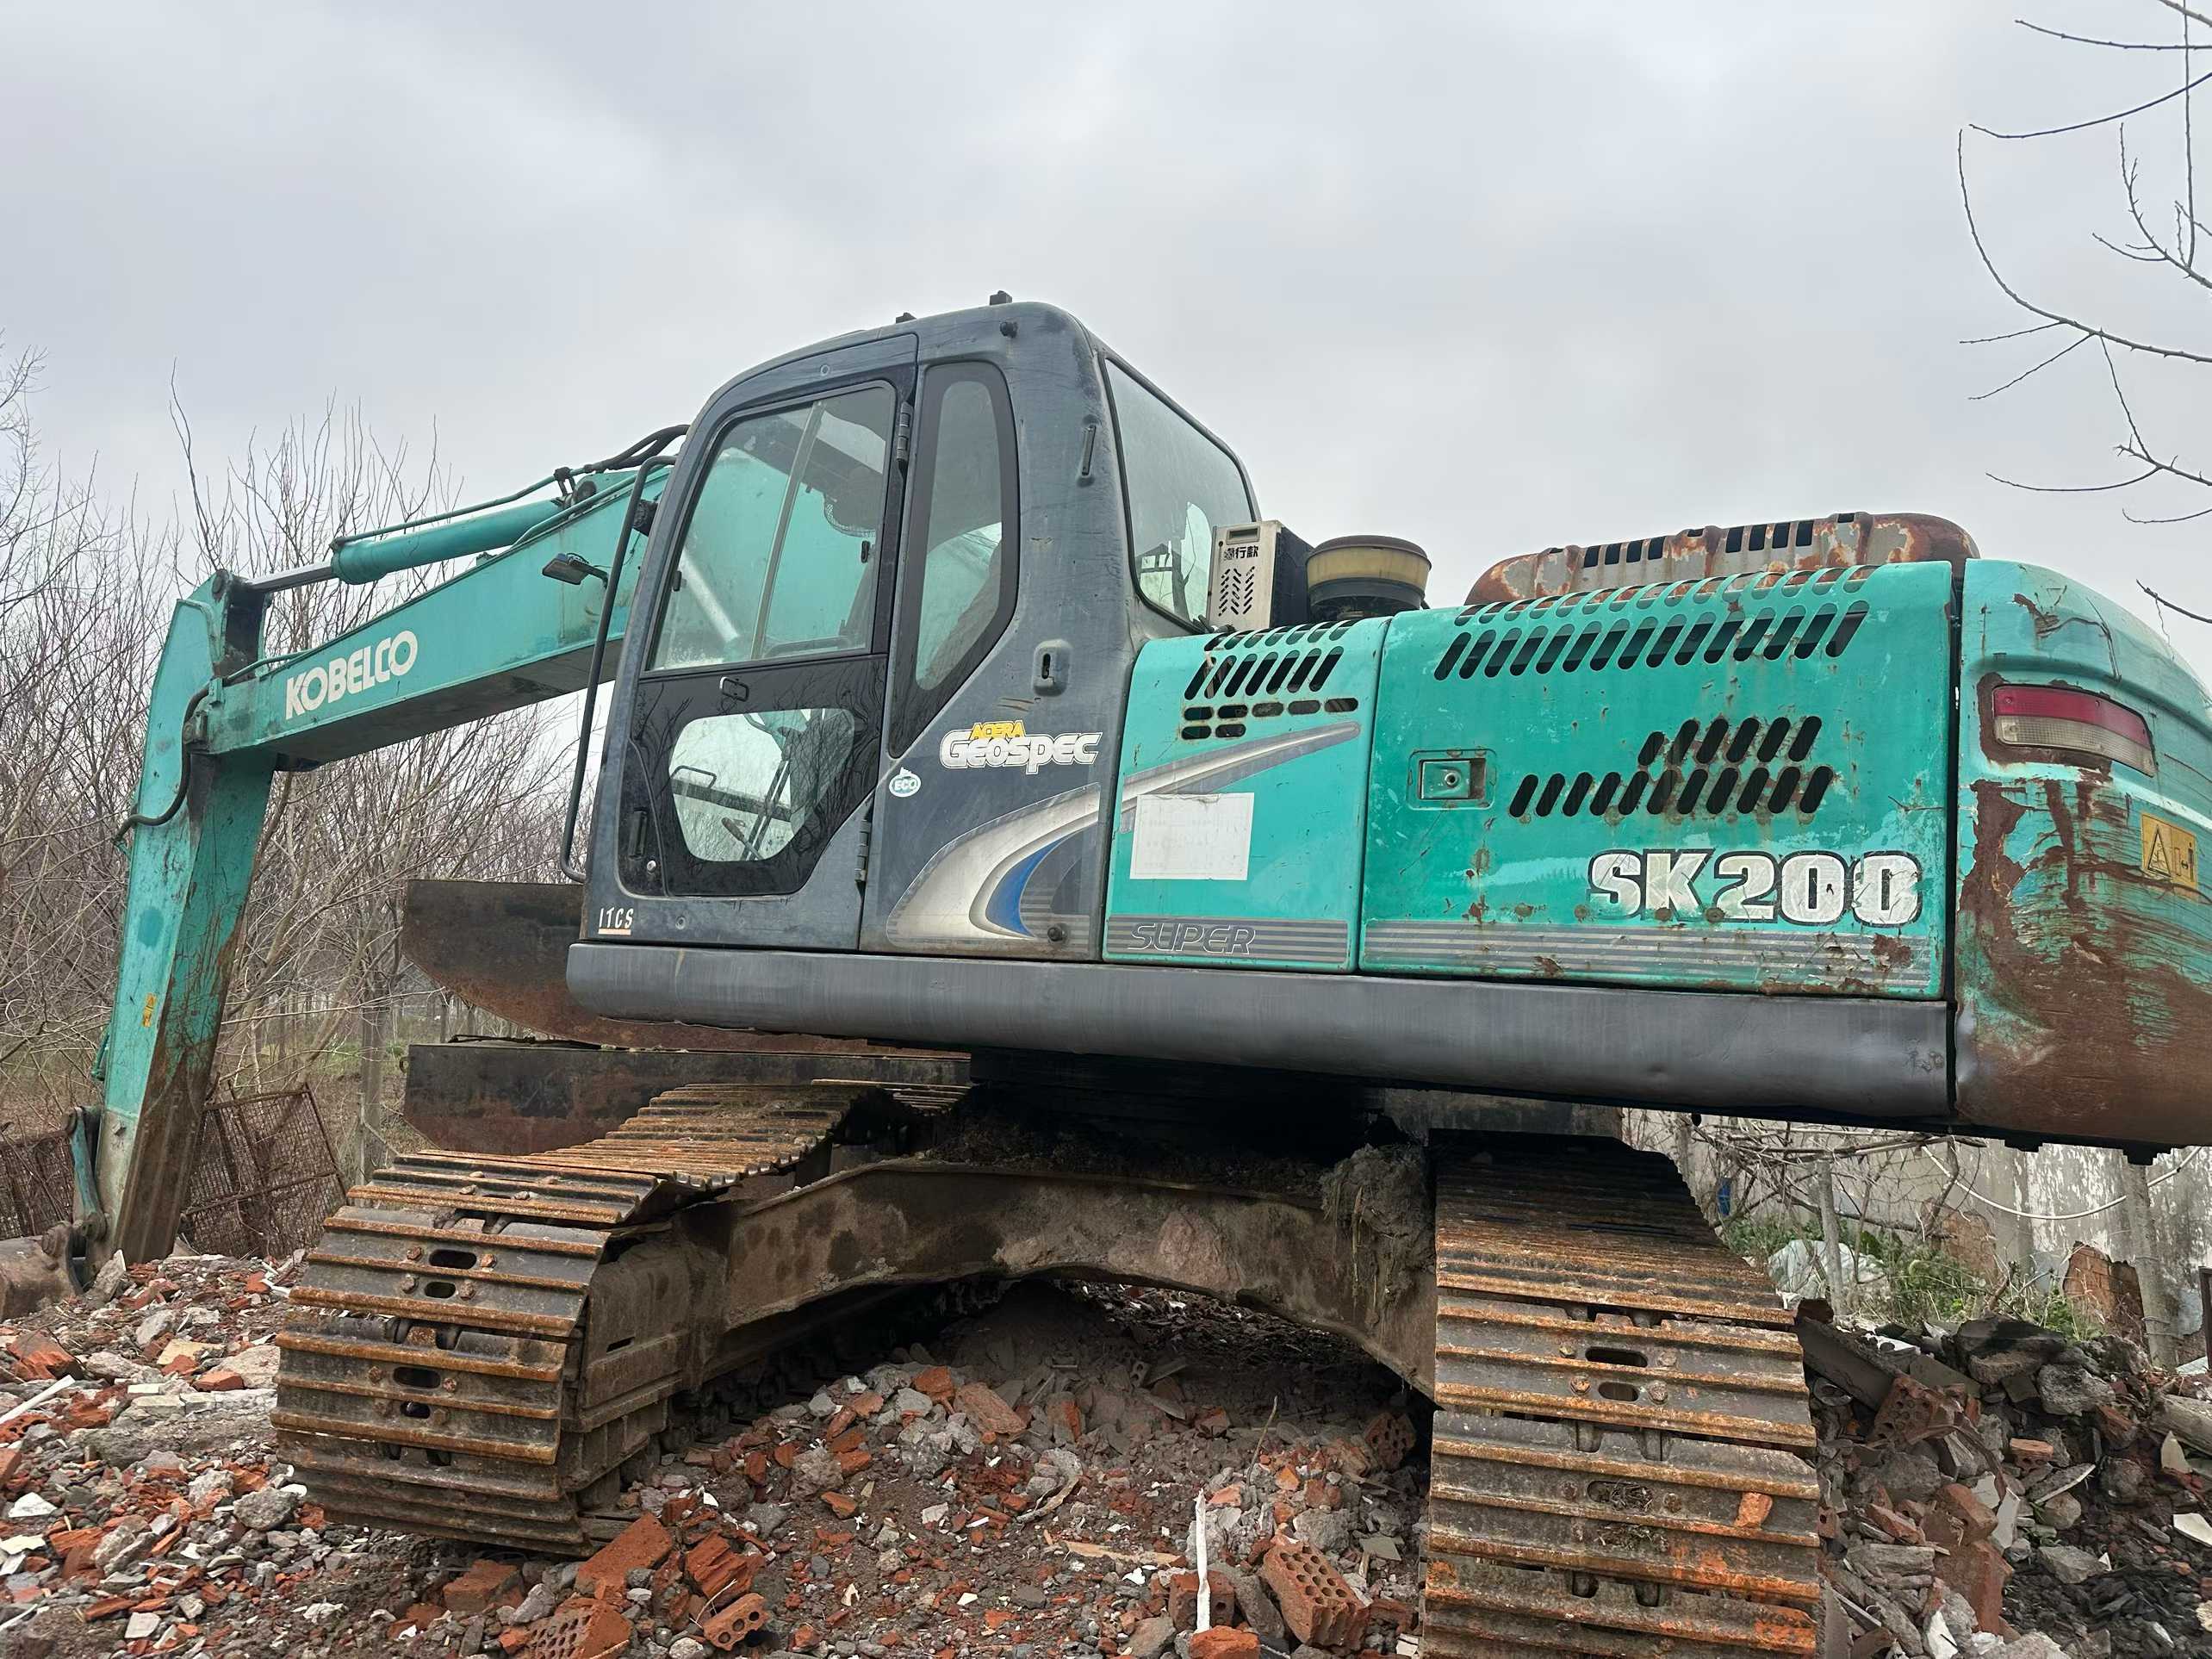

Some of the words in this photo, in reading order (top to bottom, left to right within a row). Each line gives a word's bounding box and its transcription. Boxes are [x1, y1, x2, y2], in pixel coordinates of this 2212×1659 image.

[285, 630, 418, 720] KOBELCO
[970, 721, 1024, 740] ACERA
[1587, 848, 1923, 928] SK200
[599, 907, 634, 929] ITCS
[1128, 923, 1256, 954] SUPER
